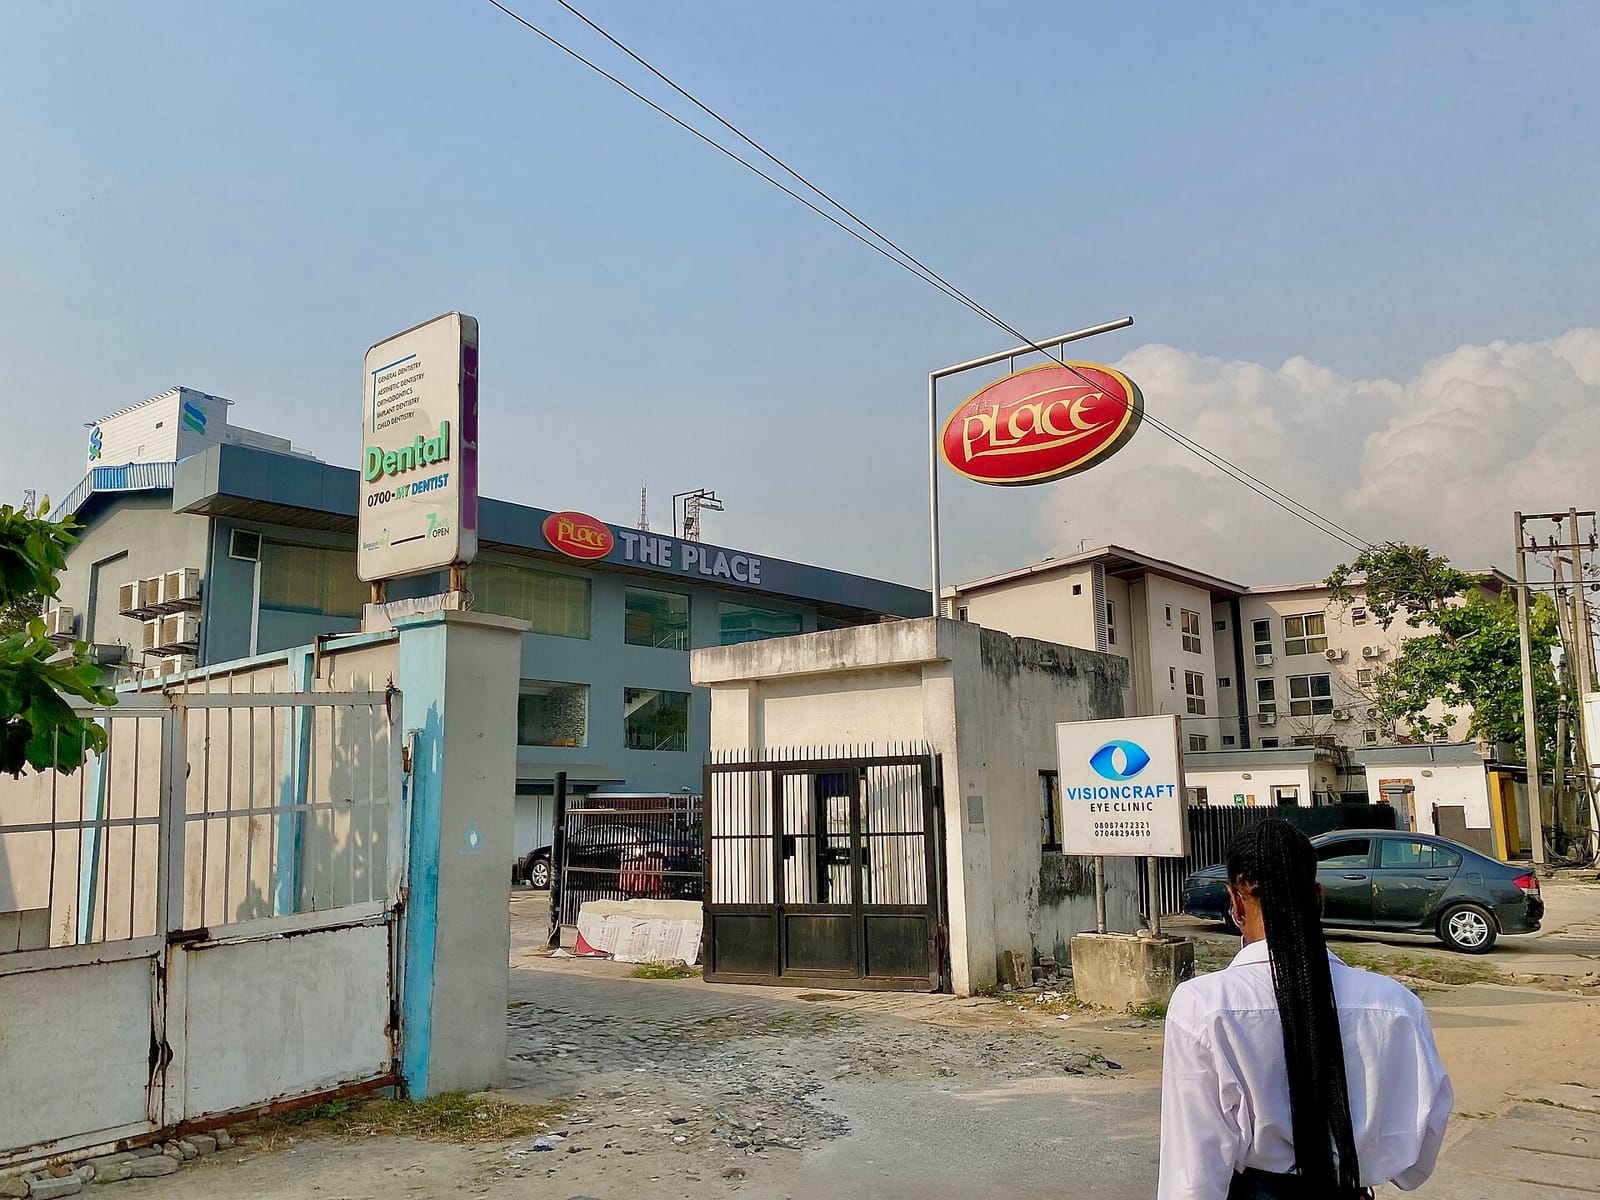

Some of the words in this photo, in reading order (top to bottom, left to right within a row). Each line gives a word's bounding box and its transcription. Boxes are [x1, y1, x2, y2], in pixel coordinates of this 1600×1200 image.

[378, 371, 397, 384] GENERAL
[398, 361, 421, 376] DENTISTRY
[377, 382, 400, 396] AESTHETIC
[400, 372, 424, 387] DENTISTRY
[377, 387, 413, 407] ORTHODONTICS
[396, 396, 420, 411] DENTISTRY
[377, 420, 391, 430] CHILD
[391, 411, 415, 425] DENTISTRY
[365, 420, 450, 483] Dental
[411, 473, 449, 496] DENTIST
[426, 512, 438, 539] 7
[432, 526, 450, 538] OPEN
[619, 531, 672, 568] THE
[681, 544, 761, 584] PLACE
[1067, 784, 1175, 800] VISIONCRAFT
[1090, 802, 1110, 812] EYE
[1114, 801, 1153, 812] CLINIC
